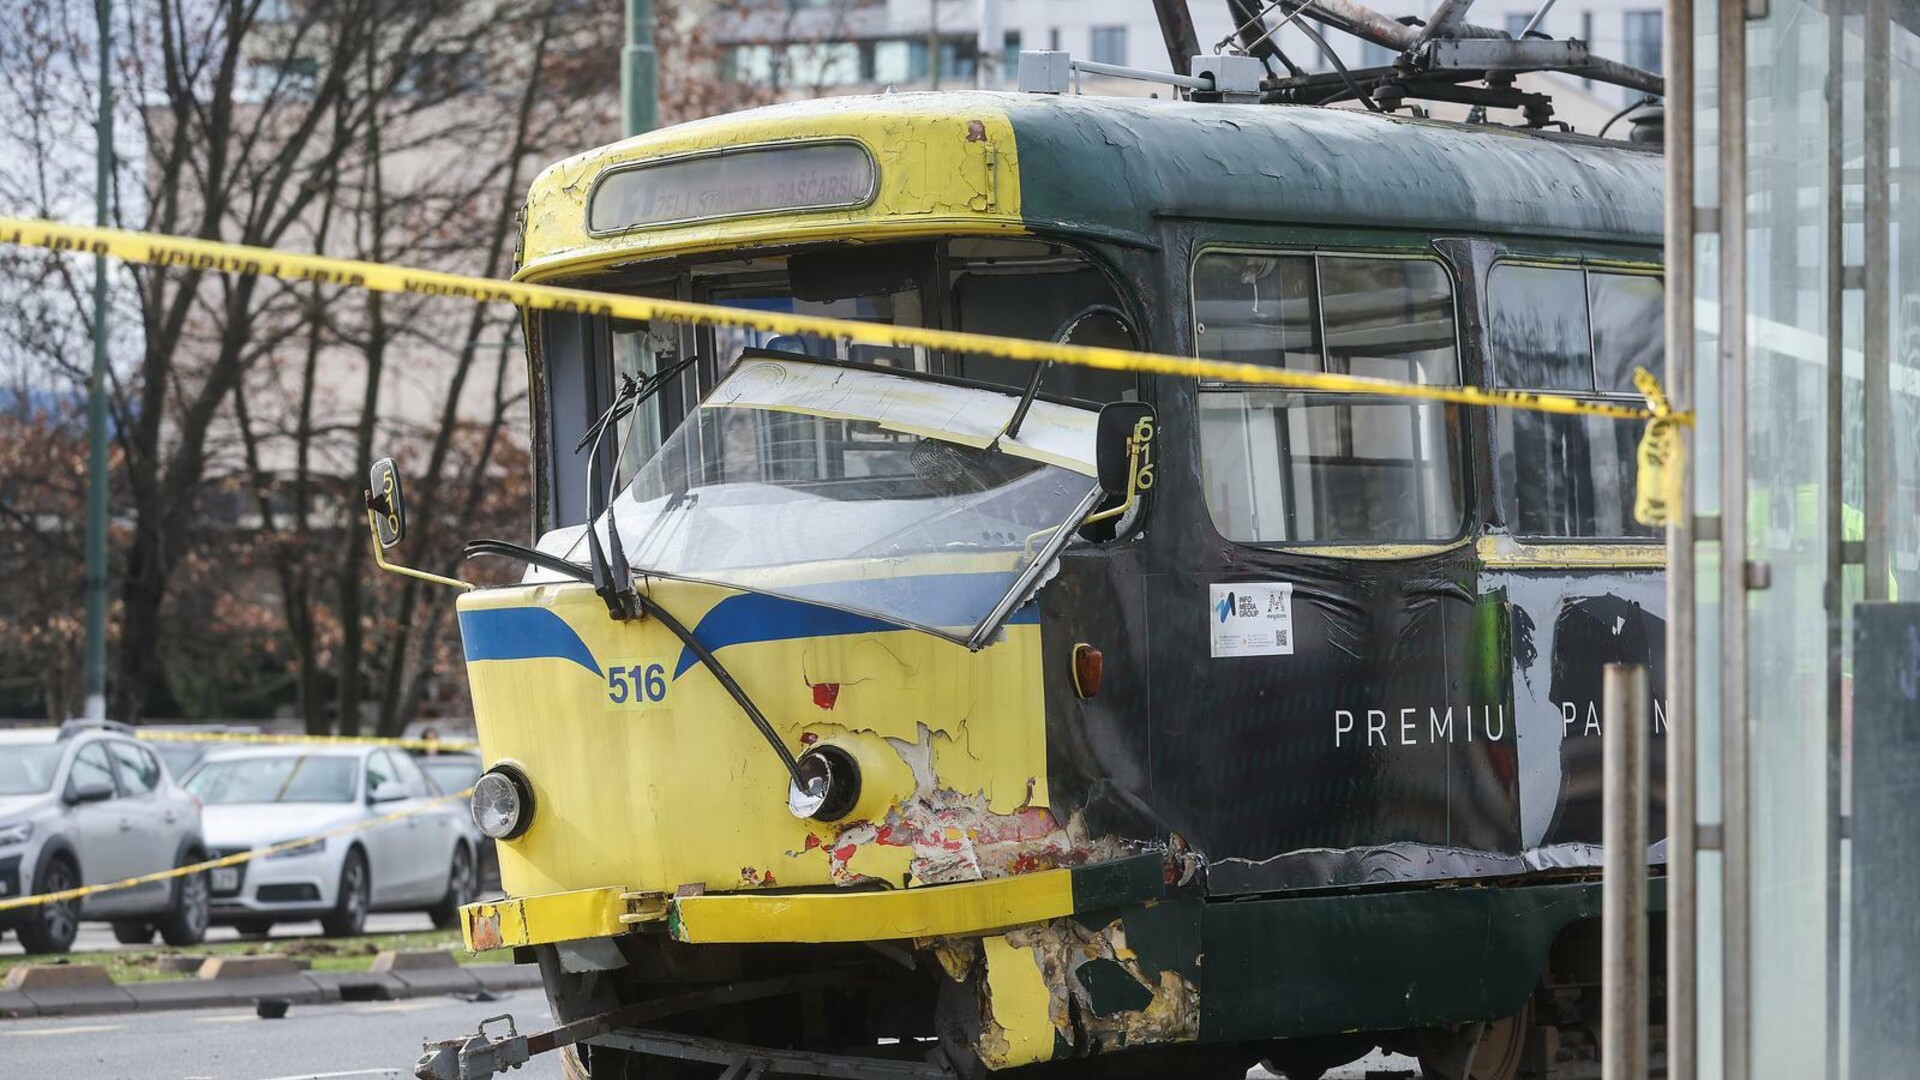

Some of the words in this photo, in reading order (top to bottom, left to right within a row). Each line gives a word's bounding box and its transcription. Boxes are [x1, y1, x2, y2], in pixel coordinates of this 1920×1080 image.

[1239, 610, 1259, 618] GROUP
[608, 663, 667, 704] 516
[1335, 704, 1504, 747] PREMIU
[1562, 698, 1670, 737] PAN
